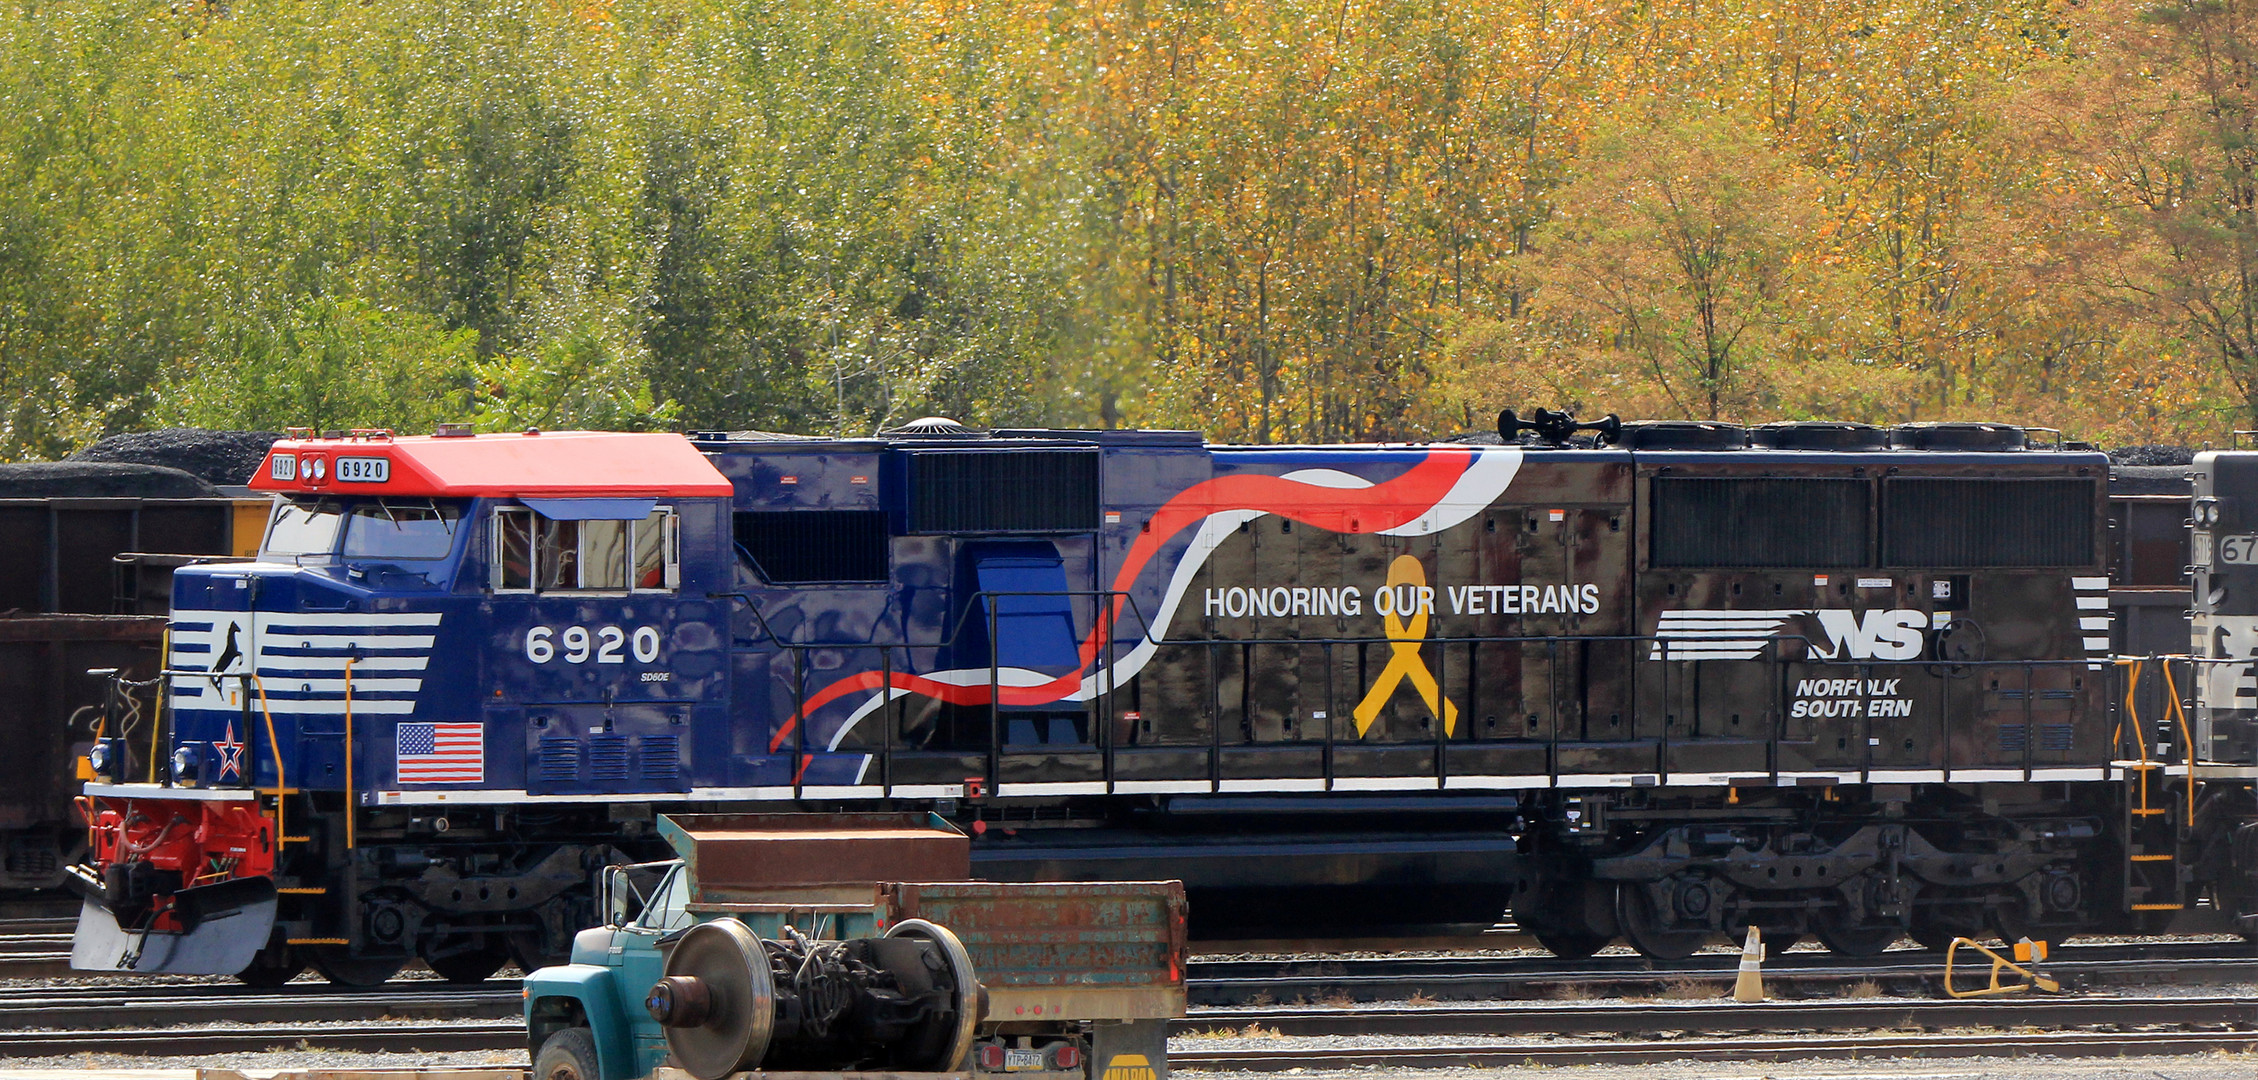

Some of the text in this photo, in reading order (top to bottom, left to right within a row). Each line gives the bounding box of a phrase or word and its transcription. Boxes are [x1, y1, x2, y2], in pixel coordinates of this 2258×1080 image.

[274, 459, 294, 476] 6920
[343, 461, 383, 478] 6920
[2222, 538, 2257, 561] 67
[1205, 583, 1600, 617] HONORING OUR VETERANS
[526, 625, 660, 664] 6920
[1807, 609, 1928, 661] NS
[641, 672, 670, 682] SD60E
[1795, 678, 1901, 697] NORFOLK
[361, 792, 370, 804] F
